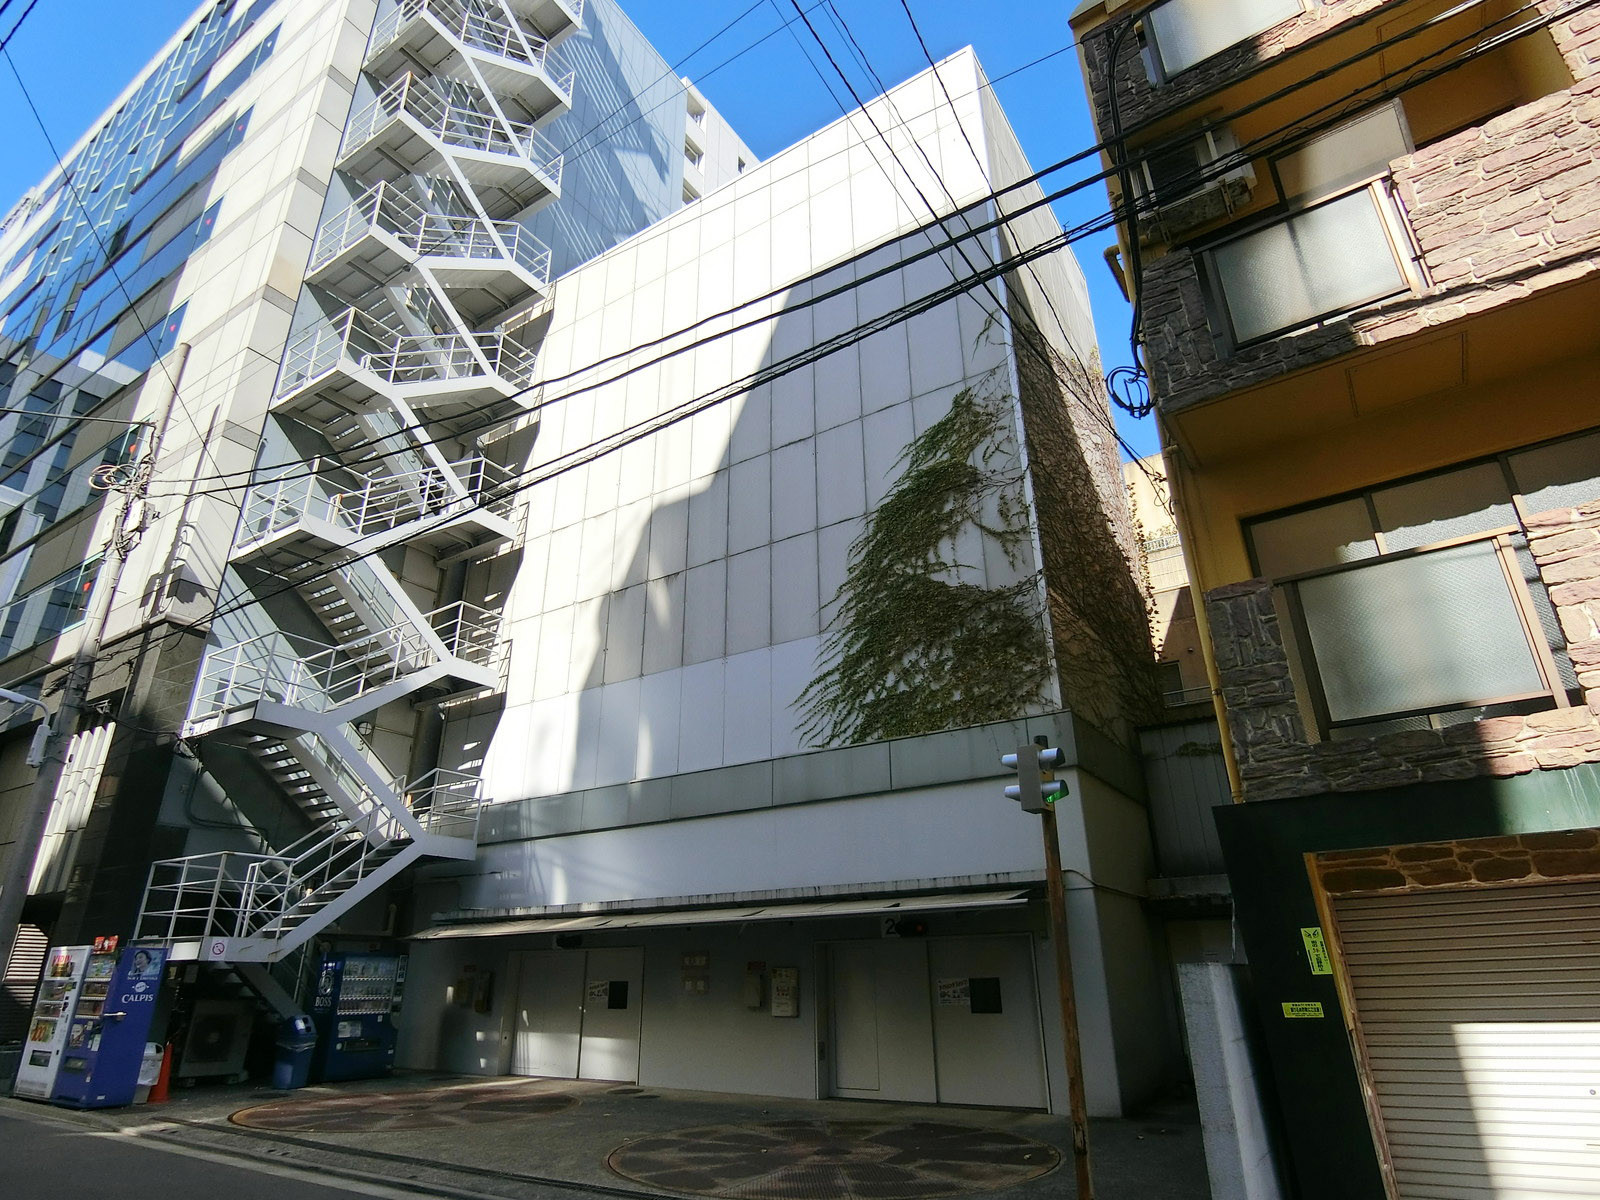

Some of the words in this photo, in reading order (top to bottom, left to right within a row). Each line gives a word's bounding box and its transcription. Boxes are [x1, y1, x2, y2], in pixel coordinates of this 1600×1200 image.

[357, 739, 364, 751] 3
[885, 918, 896, 935] 2
[121, 994, 154, 1004] CALPIS
[315, 996, 332, 1007] BOSS
